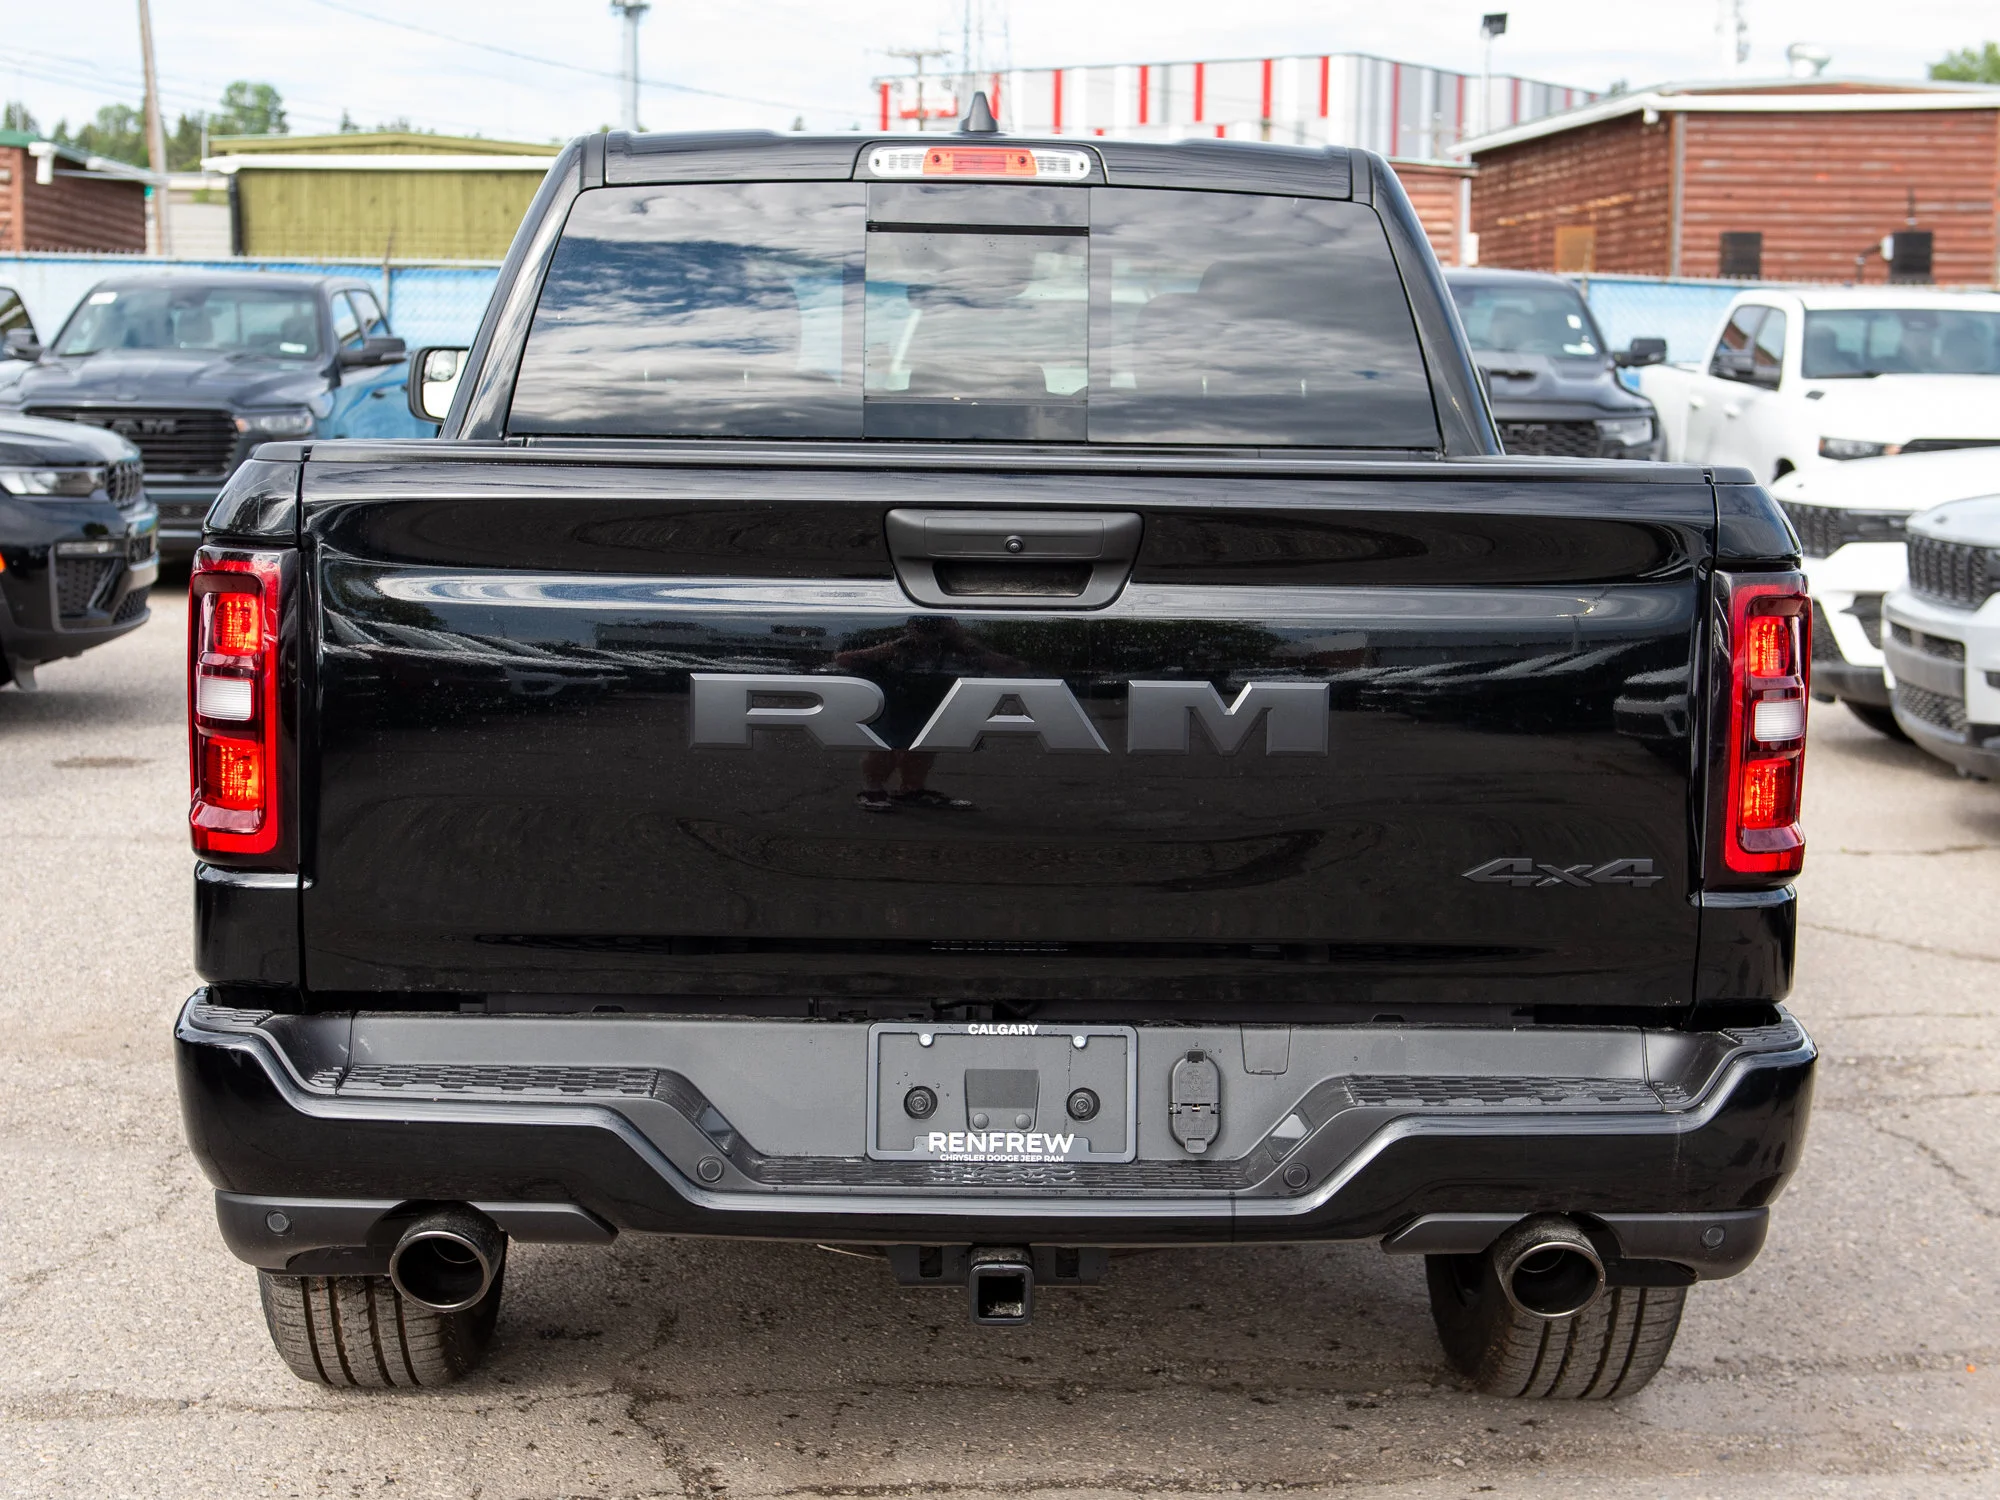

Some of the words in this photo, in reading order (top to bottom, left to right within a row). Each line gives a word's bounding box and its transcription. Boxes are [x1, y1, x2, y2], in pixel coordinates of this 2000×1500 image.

[689, 672, 1330, 756] RAM
[1461, 857, 1664, 887] 4x4
[967, 1023, 1039, 1036] CALGARY
[928, 1131, 1075, 1154] RENFREW
[940, 1154, 986, 1162] CHRYSLER
[987, 1154, 1020, 1162] DODGE
[1021, 1154, 1043, 1163] JEEP
[1044, 1155, 1065, 1163] RAM
